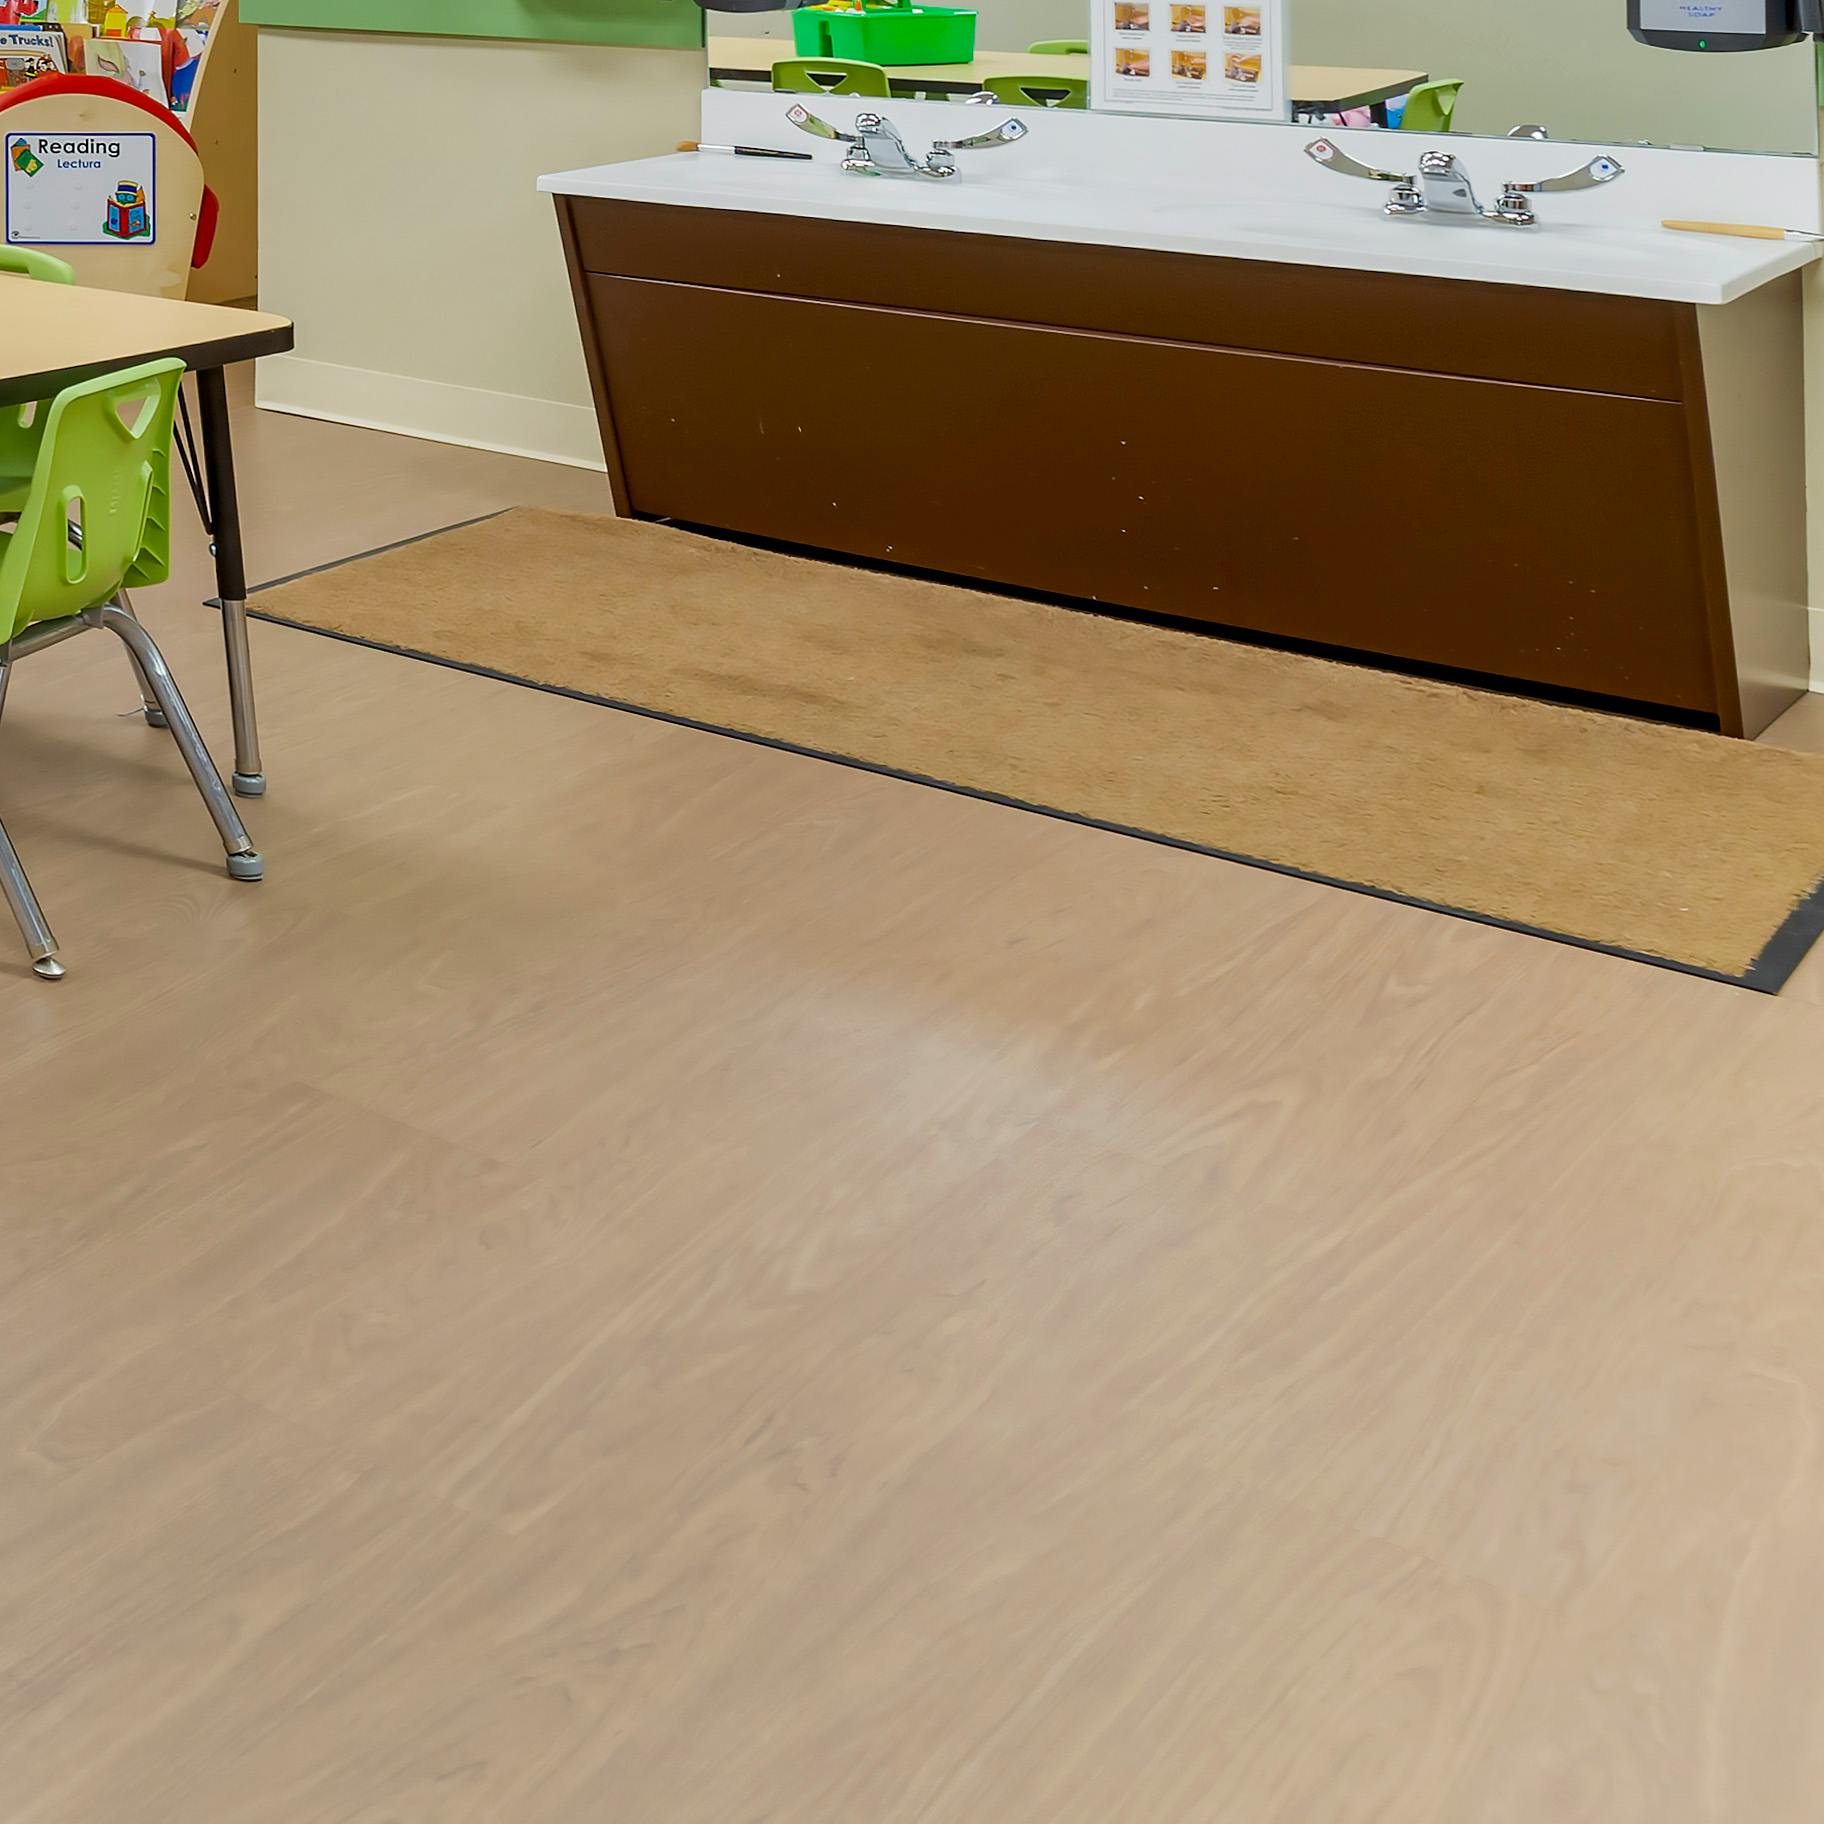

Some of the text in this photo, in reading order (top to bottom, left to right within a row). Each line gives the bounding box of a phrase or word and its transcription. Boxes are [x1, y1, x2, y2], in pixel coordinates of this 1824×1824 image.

[9, 34, 54, 48] Trucks!
[38, 139, 121, 158] Reading
[57, 159, 102, 169] Lectura
